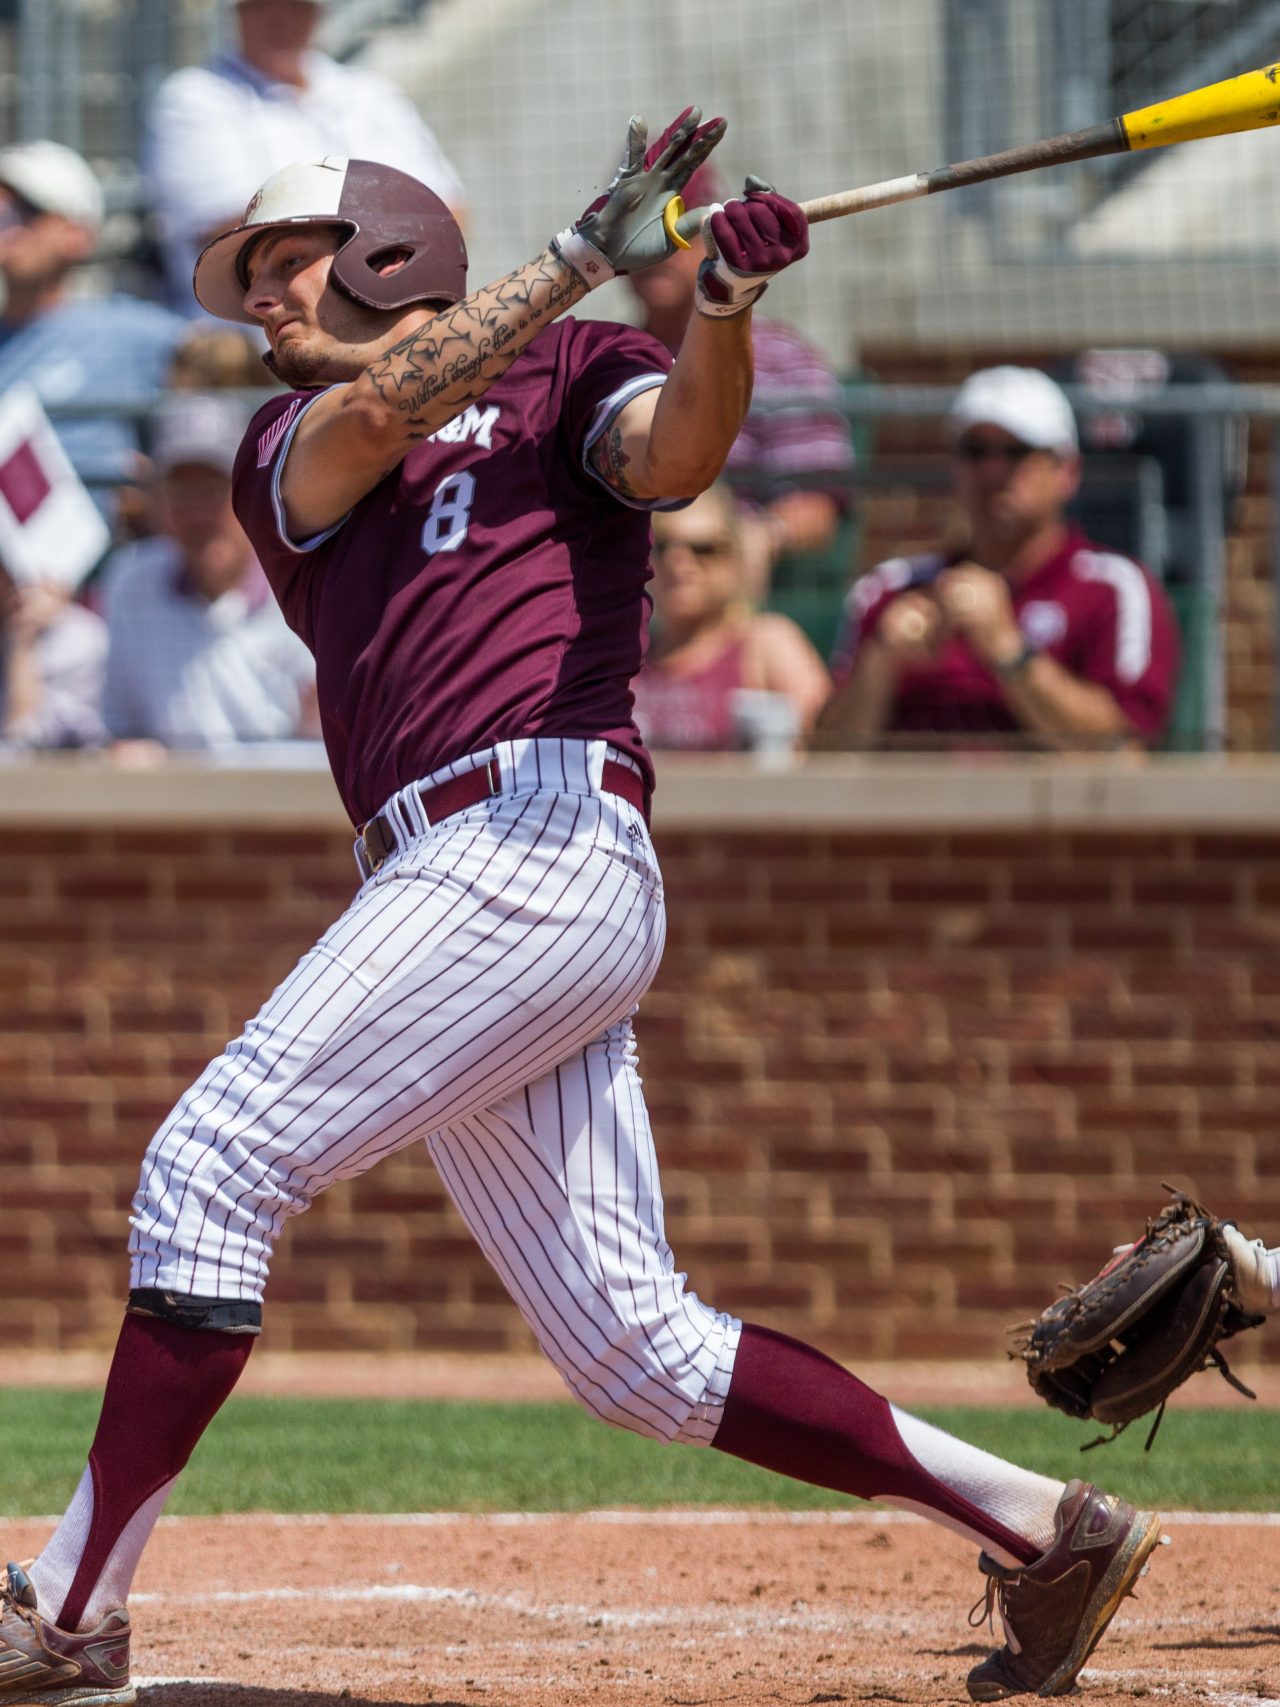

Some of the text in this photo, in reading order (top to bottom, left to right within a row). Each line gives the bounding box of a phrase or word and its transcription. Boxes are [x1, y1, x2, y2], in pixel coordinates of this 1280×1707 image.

[398, 363, 454, 414] Without
[493, 323, 516, 350] there
[530, 308, 542, 321] no
[426, 403, 500, 450] &M
[421, 470, 476, 556] 8
